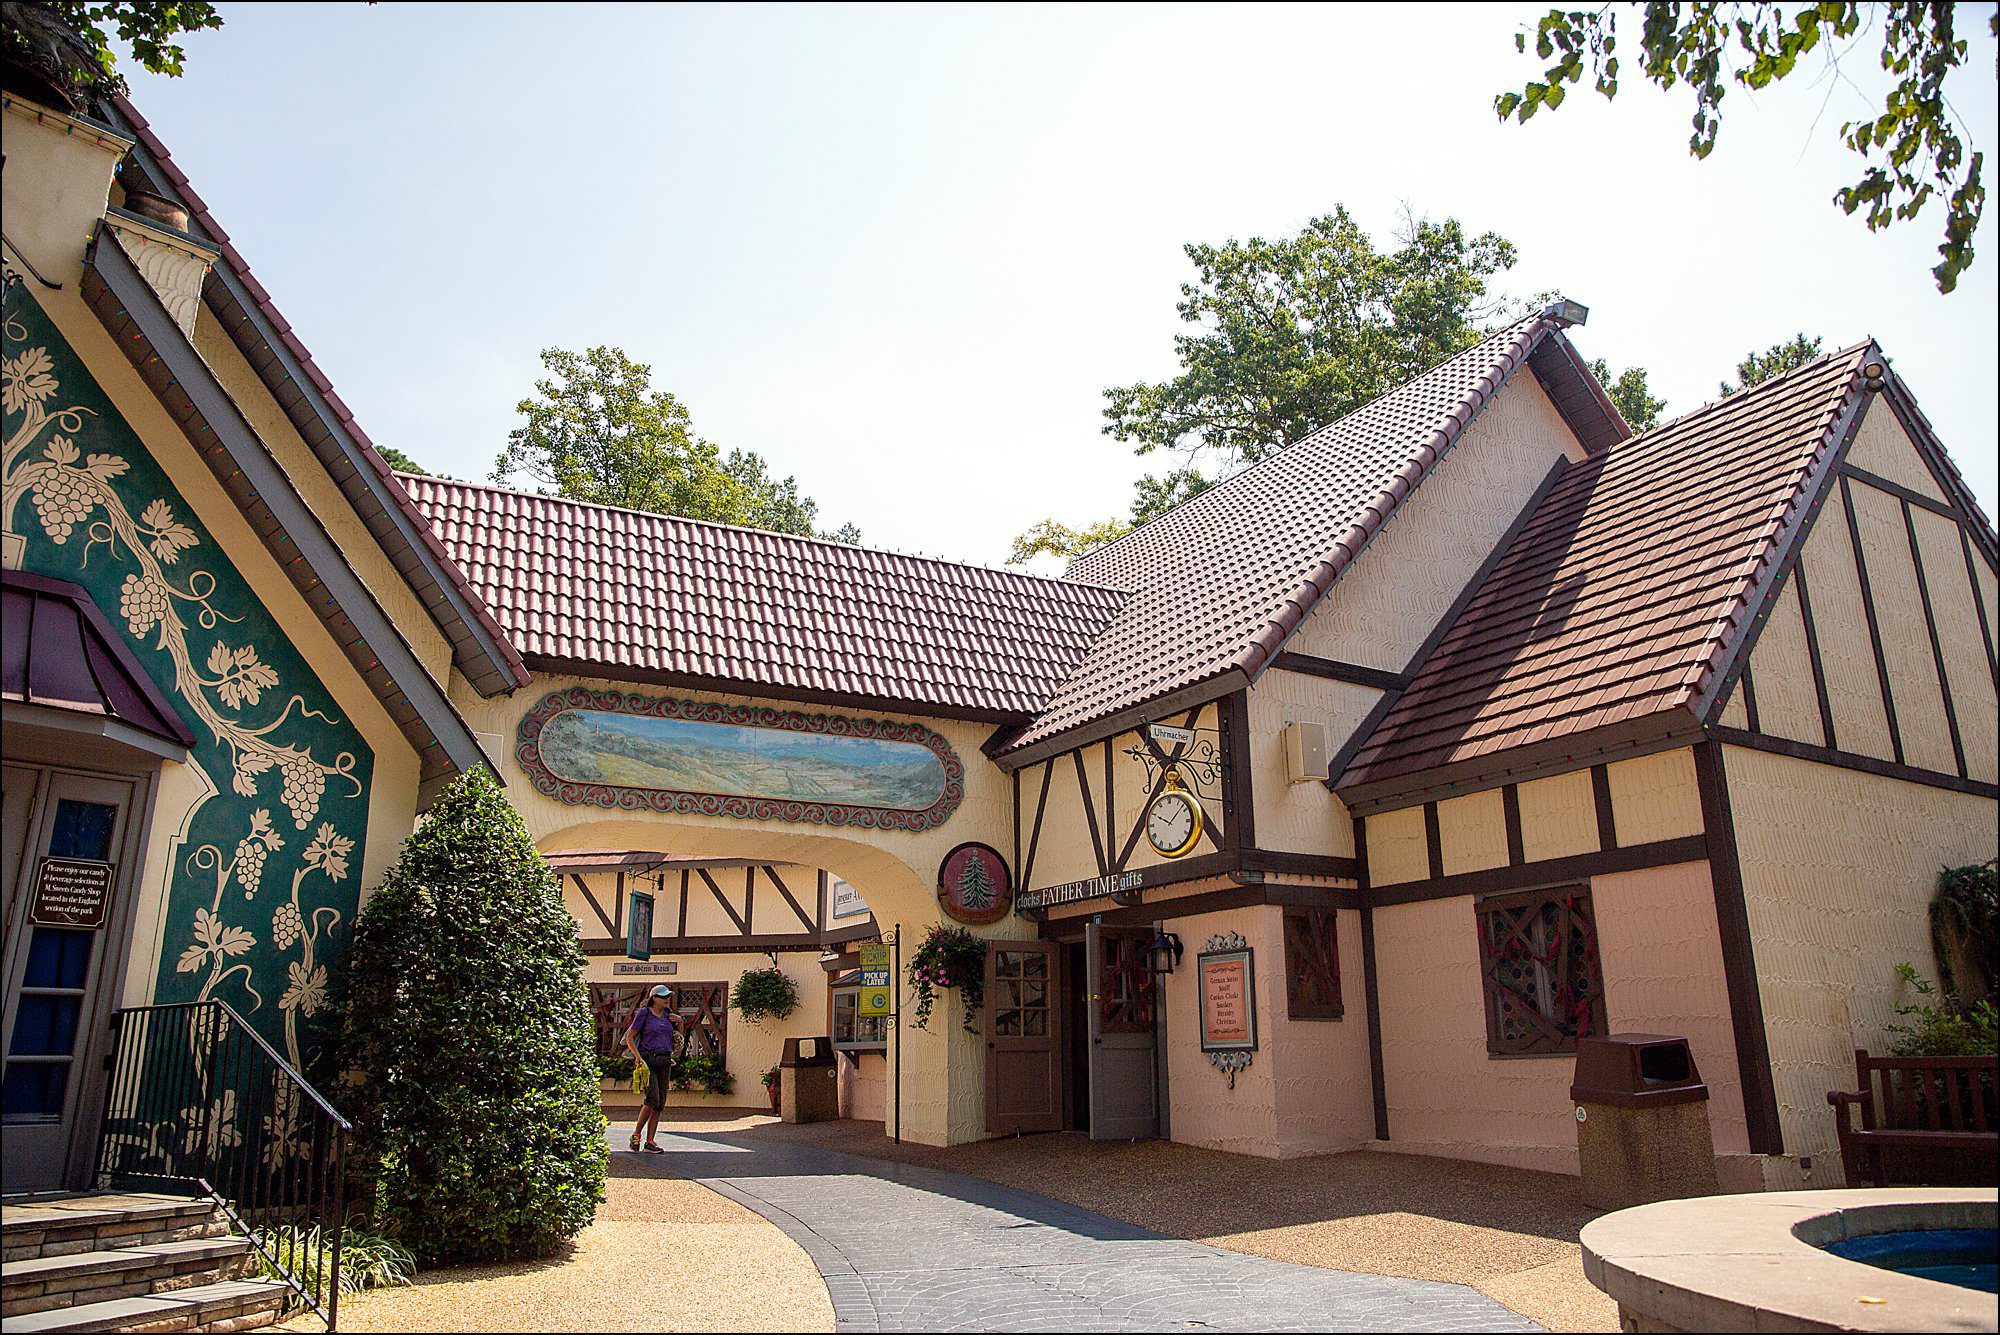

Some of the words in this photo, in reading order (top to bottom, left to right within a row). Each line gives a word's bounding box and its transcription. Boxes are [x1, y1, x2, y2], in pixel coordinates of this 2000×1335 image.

[1154, 728, 1188, 740] Uhrmacher
[47, 864, 64, 872] Please
[64, 866, 79, 875] enjoy
[89, 869, 105, 877] candy
[50, 874, 73, 883] beverage
[74, 877, 98, 886] selections
[52, 884, 69, 893] Sweets
[70, 886, 86, 895] Candy
[87, 888, 101, 896] Shop
[1017, 892, 1040, 908] clocks
[1041, 882, 1083, 906] FATHER
[1087, 874, 1119, 897] TIME
[1119, 871, 1143, 890] gifts
[42, 894, 62, 902] located
[78, 897, 100, 905] England
[862, 952, 886, 962] PICKUP
[635, 964, 652, 972] Stein
[653, 964, 669, 972] Haus
